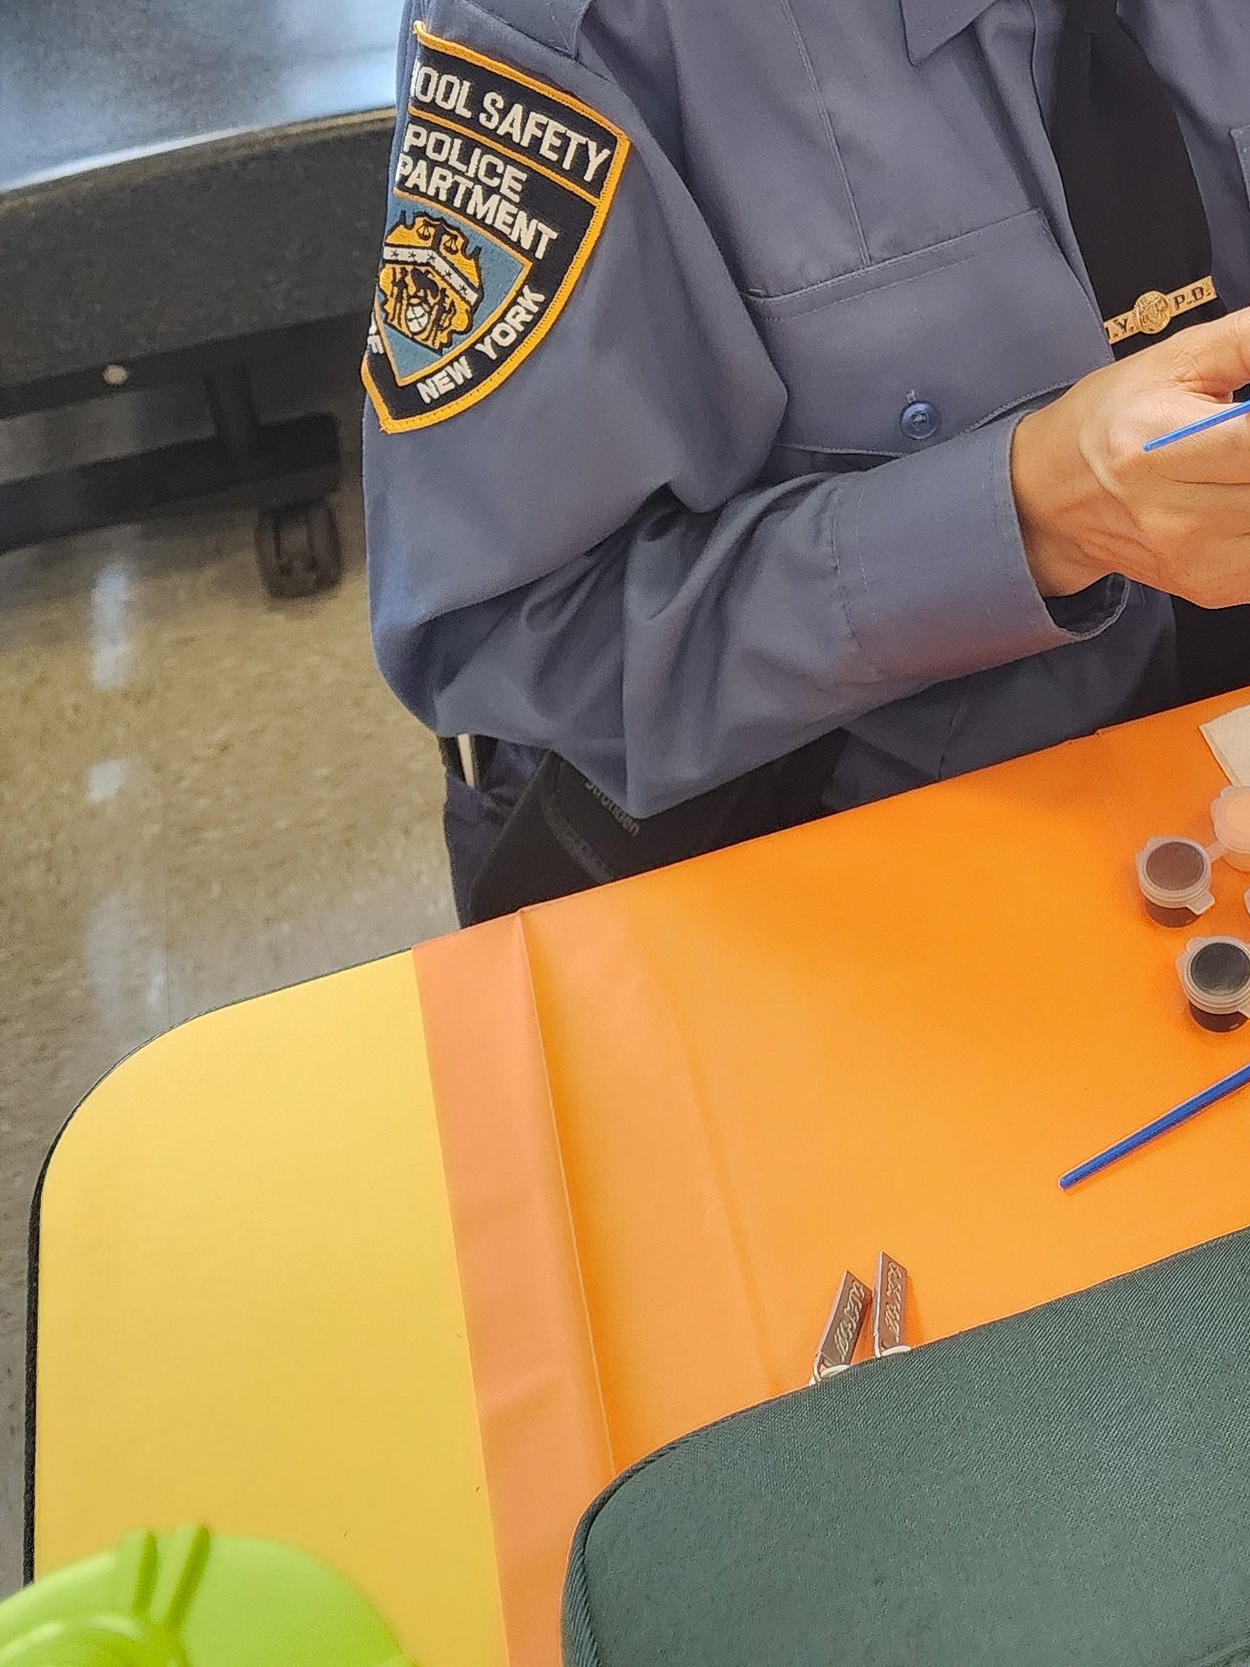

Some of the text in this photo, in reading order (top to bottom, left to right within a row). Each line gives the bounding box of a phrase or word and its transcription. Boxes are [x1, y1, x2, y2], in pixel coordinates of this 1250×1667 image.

[404, 122, 528, 204] POLICE
[410, 62, 612, 184] OOL SAFETY
[395, 152, 558, 261] PARTMENT
[416, 284, 547, 405] NEW YORK
